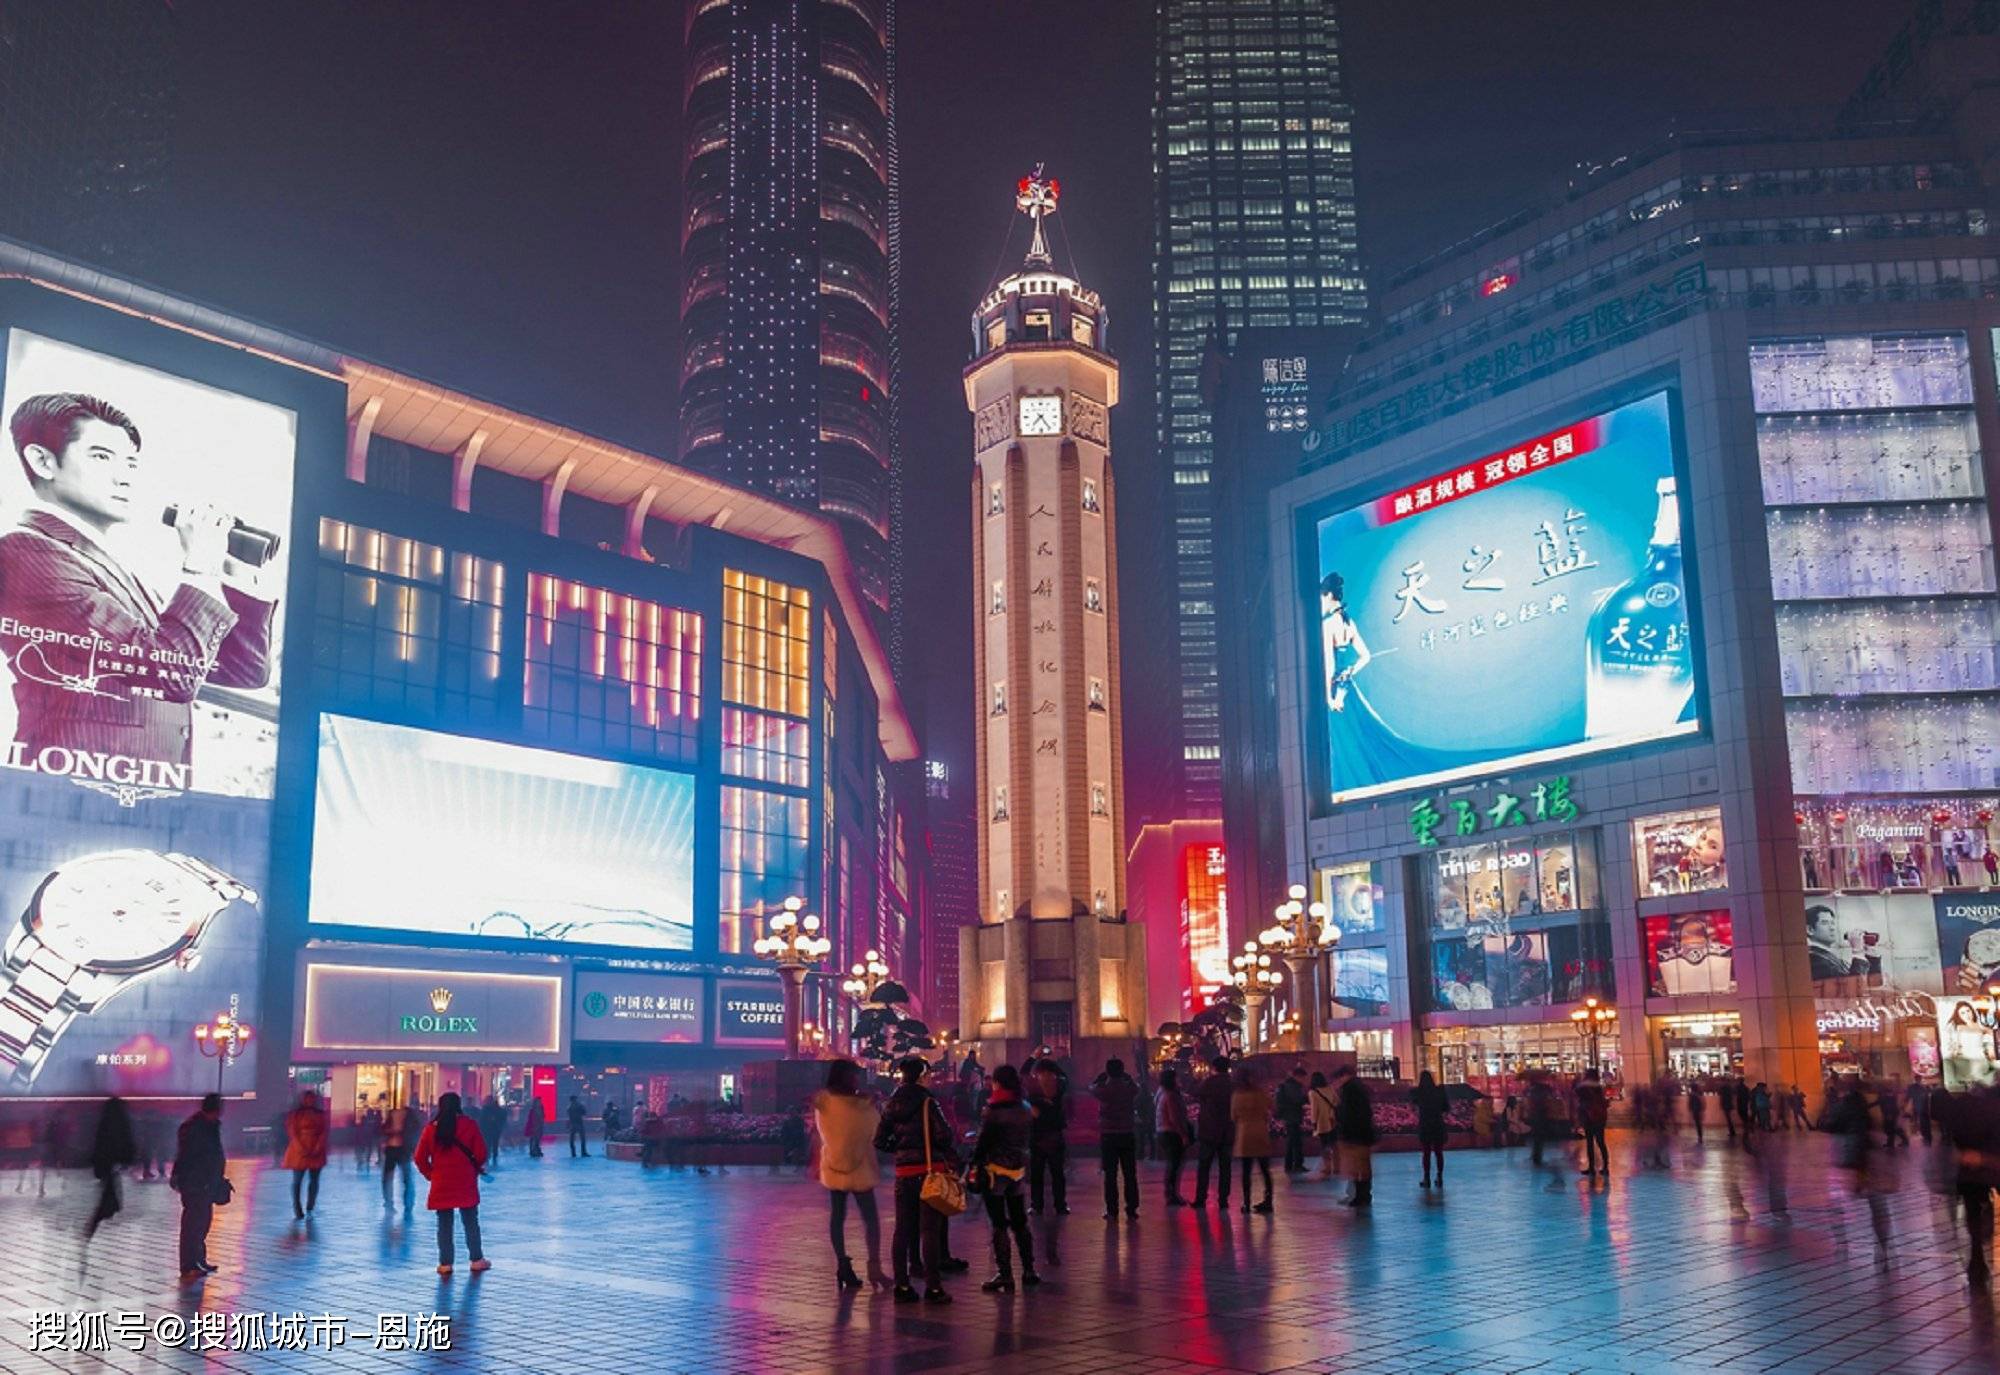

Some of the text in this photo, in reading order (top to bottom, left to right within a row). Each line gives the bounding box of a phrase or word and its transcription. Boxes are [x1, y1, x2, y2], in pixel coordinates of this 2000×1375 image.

[1, 617, 220, 672] Elegance is an attitude
[614, 995, 695, 1011] 中国农业银行
[401, 1015, 478, 1032] ROLEX
[740, 1013, 784, 1024] COFFEE
